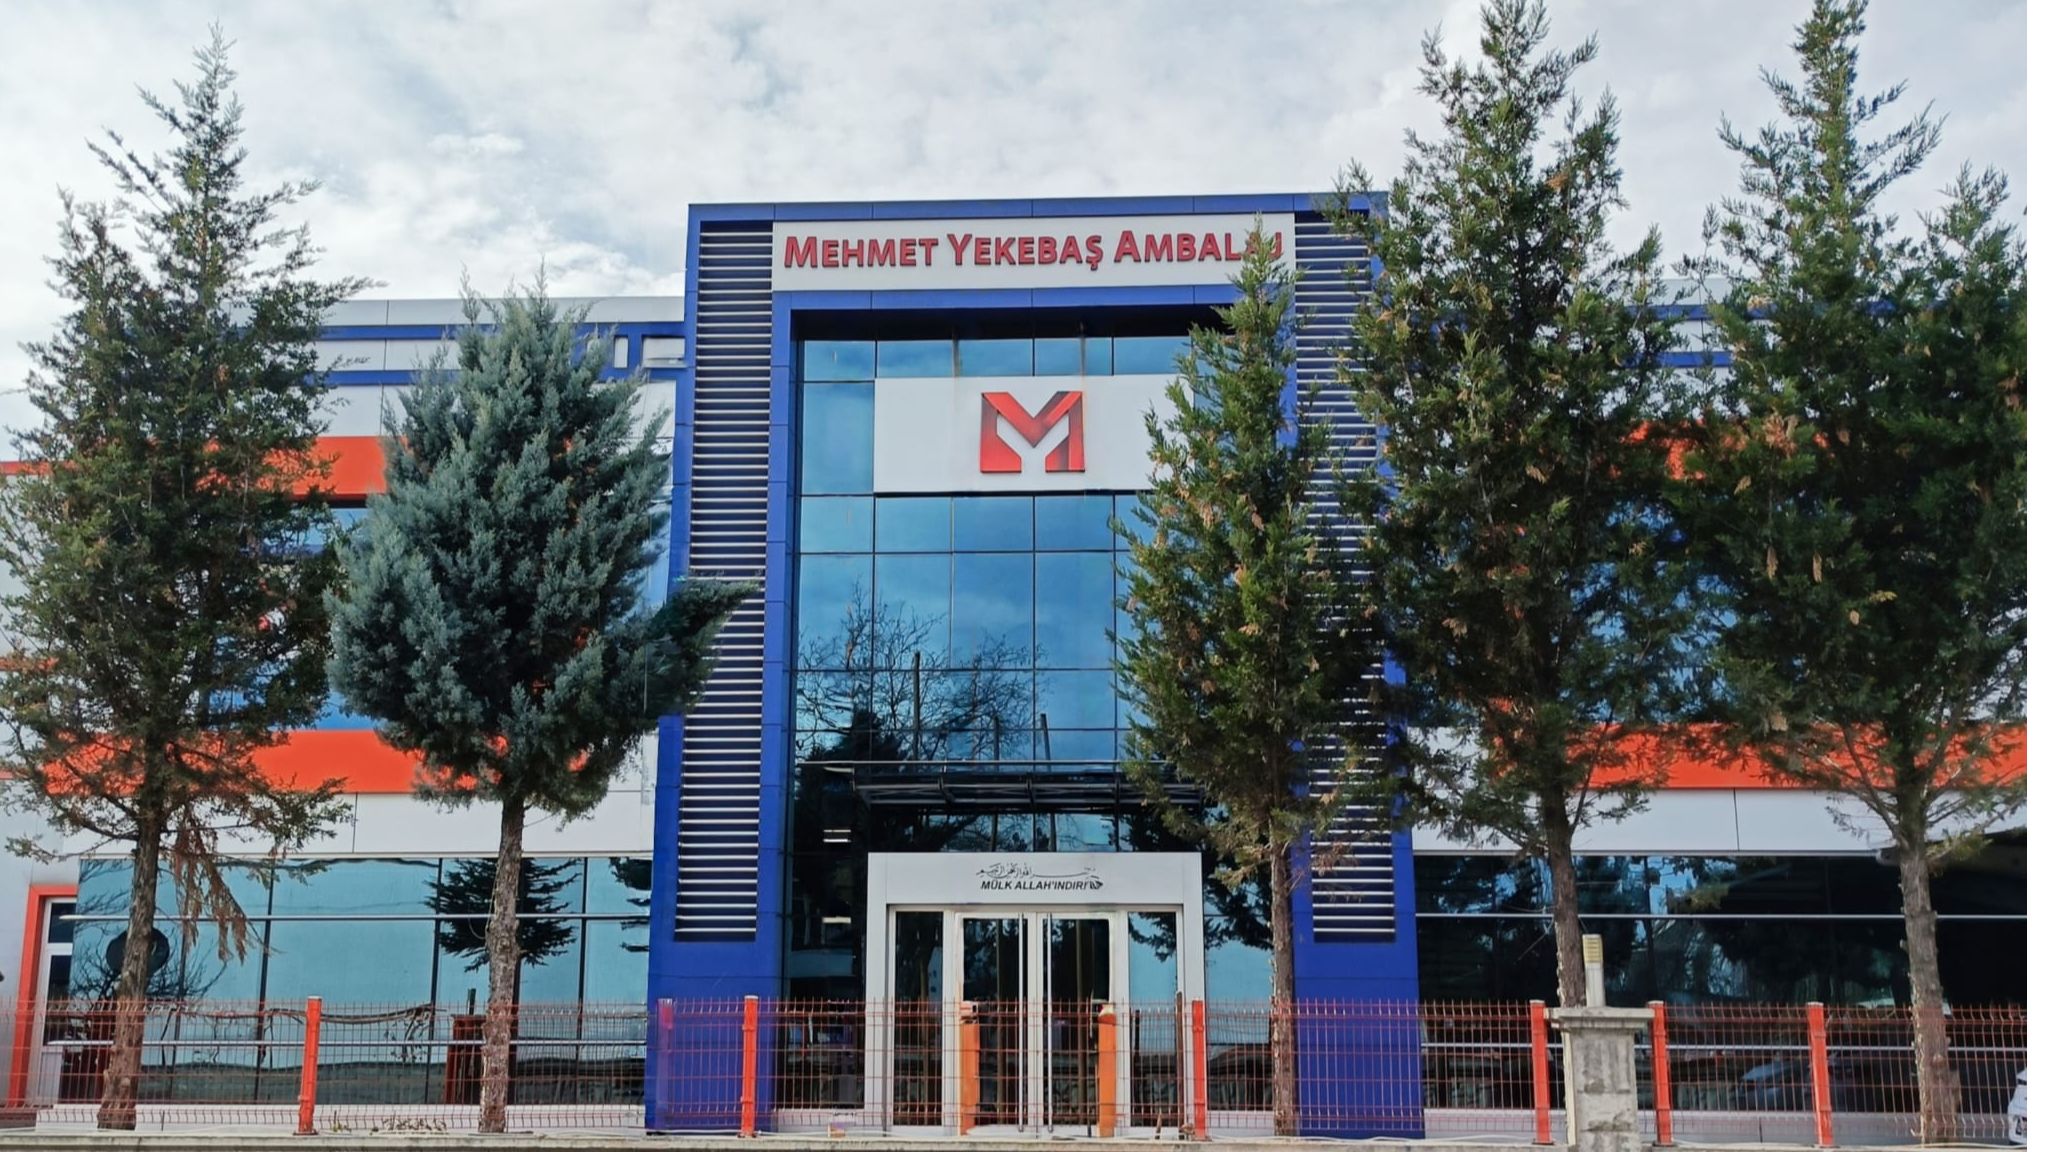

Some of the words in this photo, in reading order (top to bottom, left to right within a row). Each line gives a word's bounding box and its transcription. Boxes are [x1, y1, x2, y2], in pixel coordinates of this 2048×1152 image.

[784, 234, 939, 268] MEHMET
[946, 232, 1104, 271] YEKEBAŞ
[980, 878, 1012, 890] MÜLK
